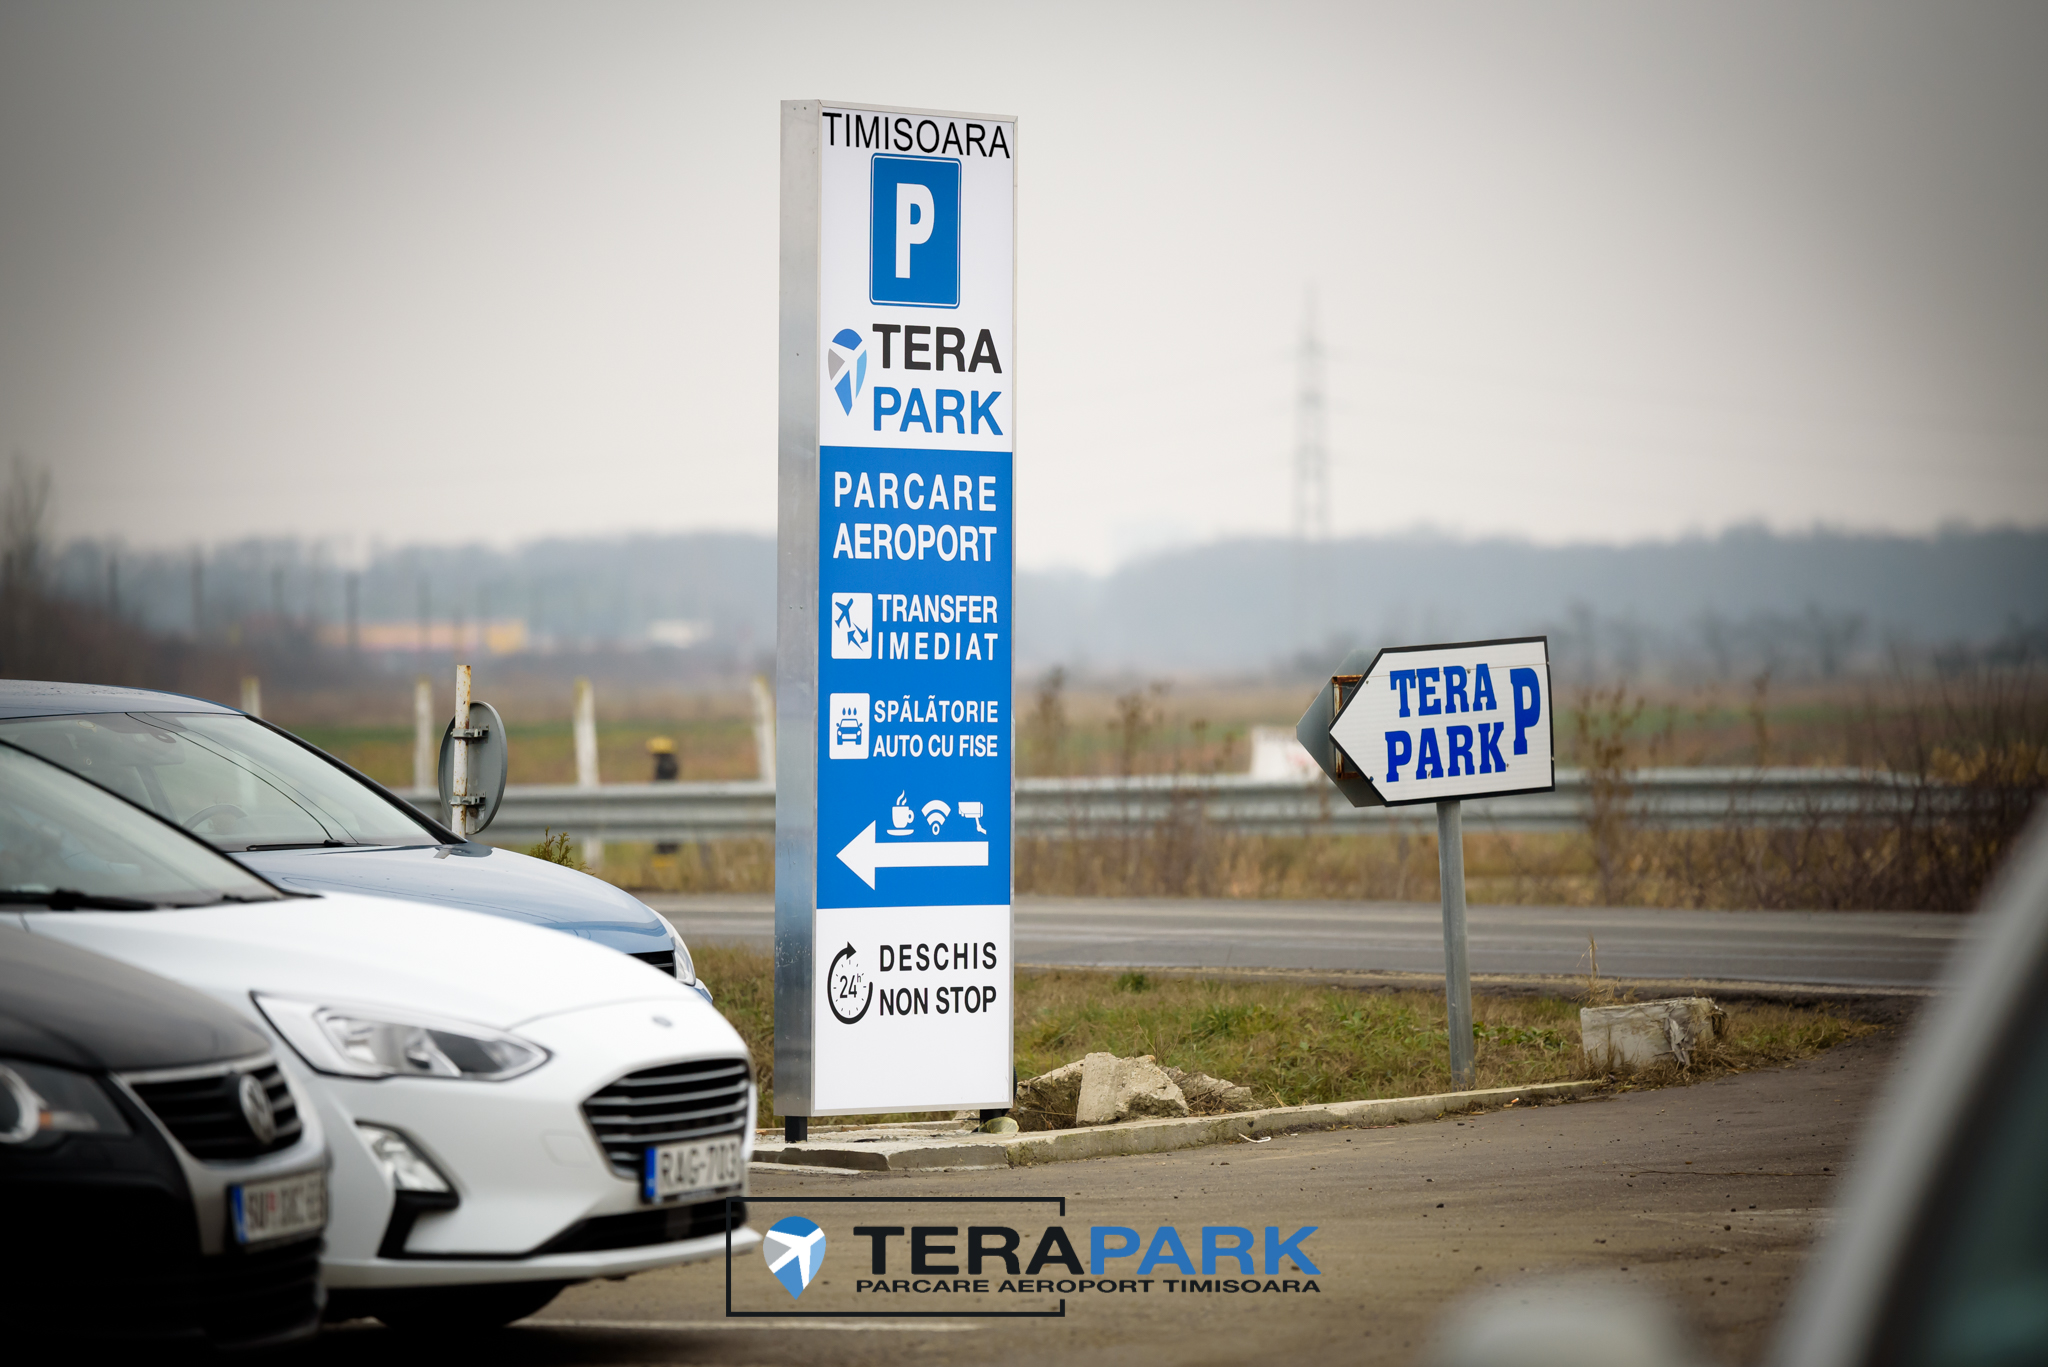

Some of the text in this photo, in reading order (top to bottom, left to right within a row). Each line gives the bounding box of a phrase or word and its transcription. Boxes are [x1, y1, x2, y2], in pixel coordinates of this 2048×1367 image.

[822, 111, 1010, 159] TIMISOARA
[895, 182, 935, 279] P
[872, 323, 1002, 374] TERA
[873, 386, 1003, 436] PARK
[834, 471, 996, 511] PARCARE
[832, 522, 997, 562] AEROPORT
[877, 594, 998, 623] TRANSFER
[878, 632, 998, 660] IMEDIAT
[1390, 663, 1498, 718] TERA
[1509, 667, 1541, 756] P
[873, 734, 998, 758] AUTO CU FISE
[1384, 721, 1507, 782] PARK
[880, 941, 997, 972] DESCHIS
[879, 985, 997, 1016] NON STOP
